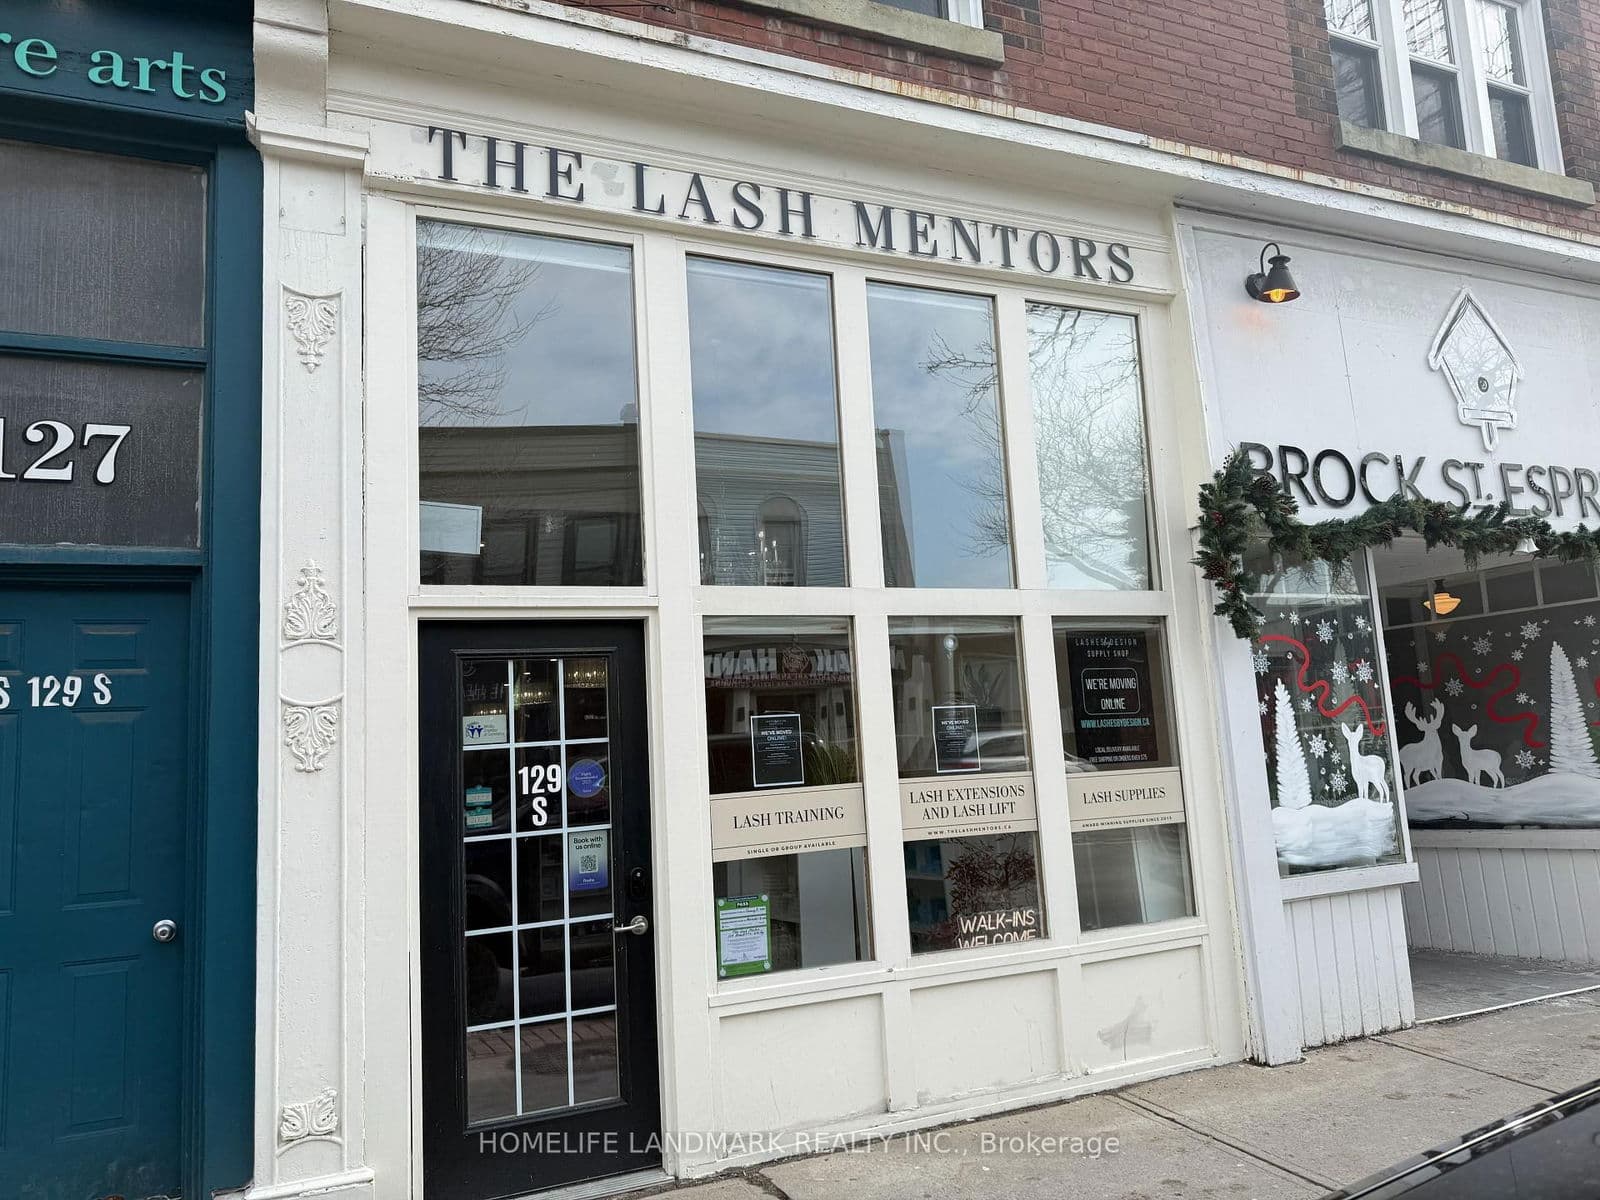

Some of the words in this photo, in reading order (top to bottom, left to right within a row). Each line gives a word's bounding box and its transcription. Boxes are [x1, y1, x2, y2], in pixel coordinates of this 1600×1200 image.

[0, 33, 57, 76] e
[88, 50, 227, 103] arts
[428, 126, 584, 202] THE
[632, 161, 817, 238] LASH
[852, 200, 1135, 283] MENTORS
[1500, 462, 1600, 519] ESPR
[27, 675, 82, 707] 129
[93, 673, 113, 705] S
[1085, 678, 1109, 690] WE'RE
[1109, 677, 1137, 690] MOVING
[1101, 697, 1126, 710] ONLINE
[518, 764, 562, 795] 129
[910, 789, 943, 804] LASH
[947, 784, 1025, 802] EXTENSIONS
[1083, 790, 1112, 804] LASH
[1114, 786, 1166, 802] SUPPLIES
[532, 796, 548, 827] S
[733, 812, 771, 829] LASH
[775, 806, 845, 825] TRAINING
[922, 806, 950, 821] AND
[953, 803, 985, 818] LASH
[989, 801, 1016, 816] LIFT
[590, 835, 603, 843] with
[804, 841, 836, 849] AVAILABLE
[960, 909, 1036, 934] WALK-INS
